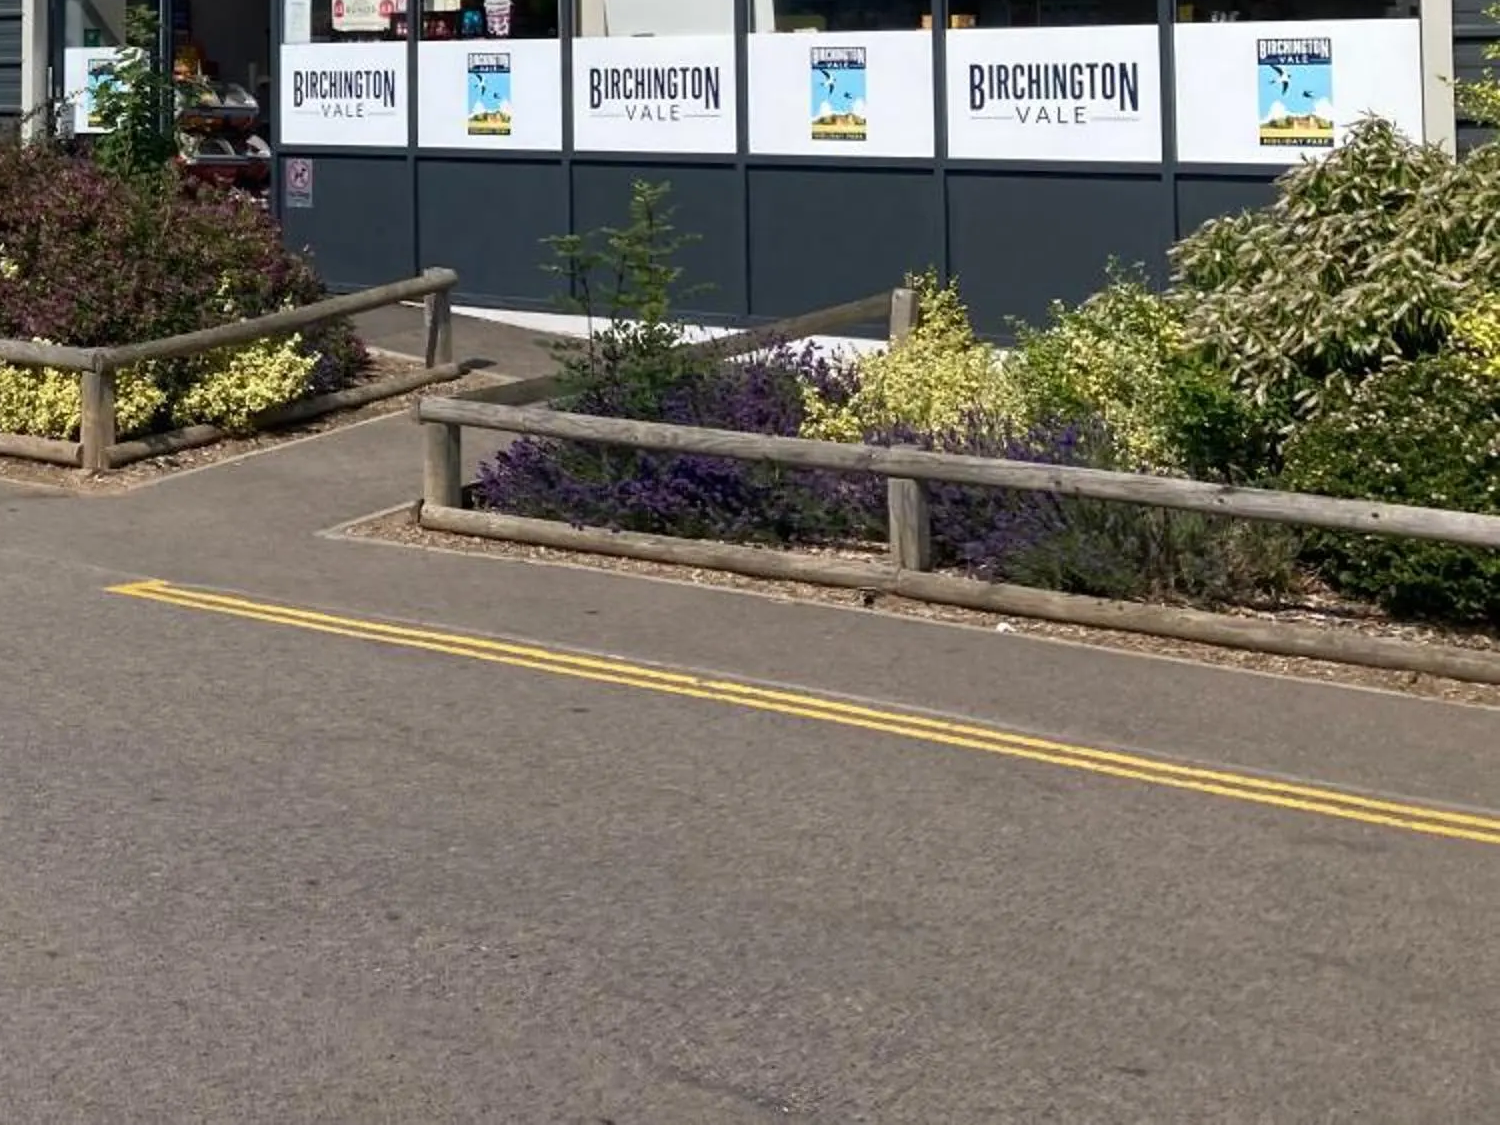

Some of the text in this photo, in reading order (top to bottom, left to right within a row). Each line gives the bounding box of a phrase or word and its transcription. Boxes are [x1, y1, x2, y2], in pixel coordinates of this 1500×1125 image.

[293, 70, 395, 108] BIRCHINGTON
[589, 67, 720, 110] BIRCHINGTON
[969, 62, 1139, 112] BIRCHINGTON
[321, 103, 365, 118] VALE
[625, 105, 680, 121] VALE
[1015, 106, 1087, 124] VALE
